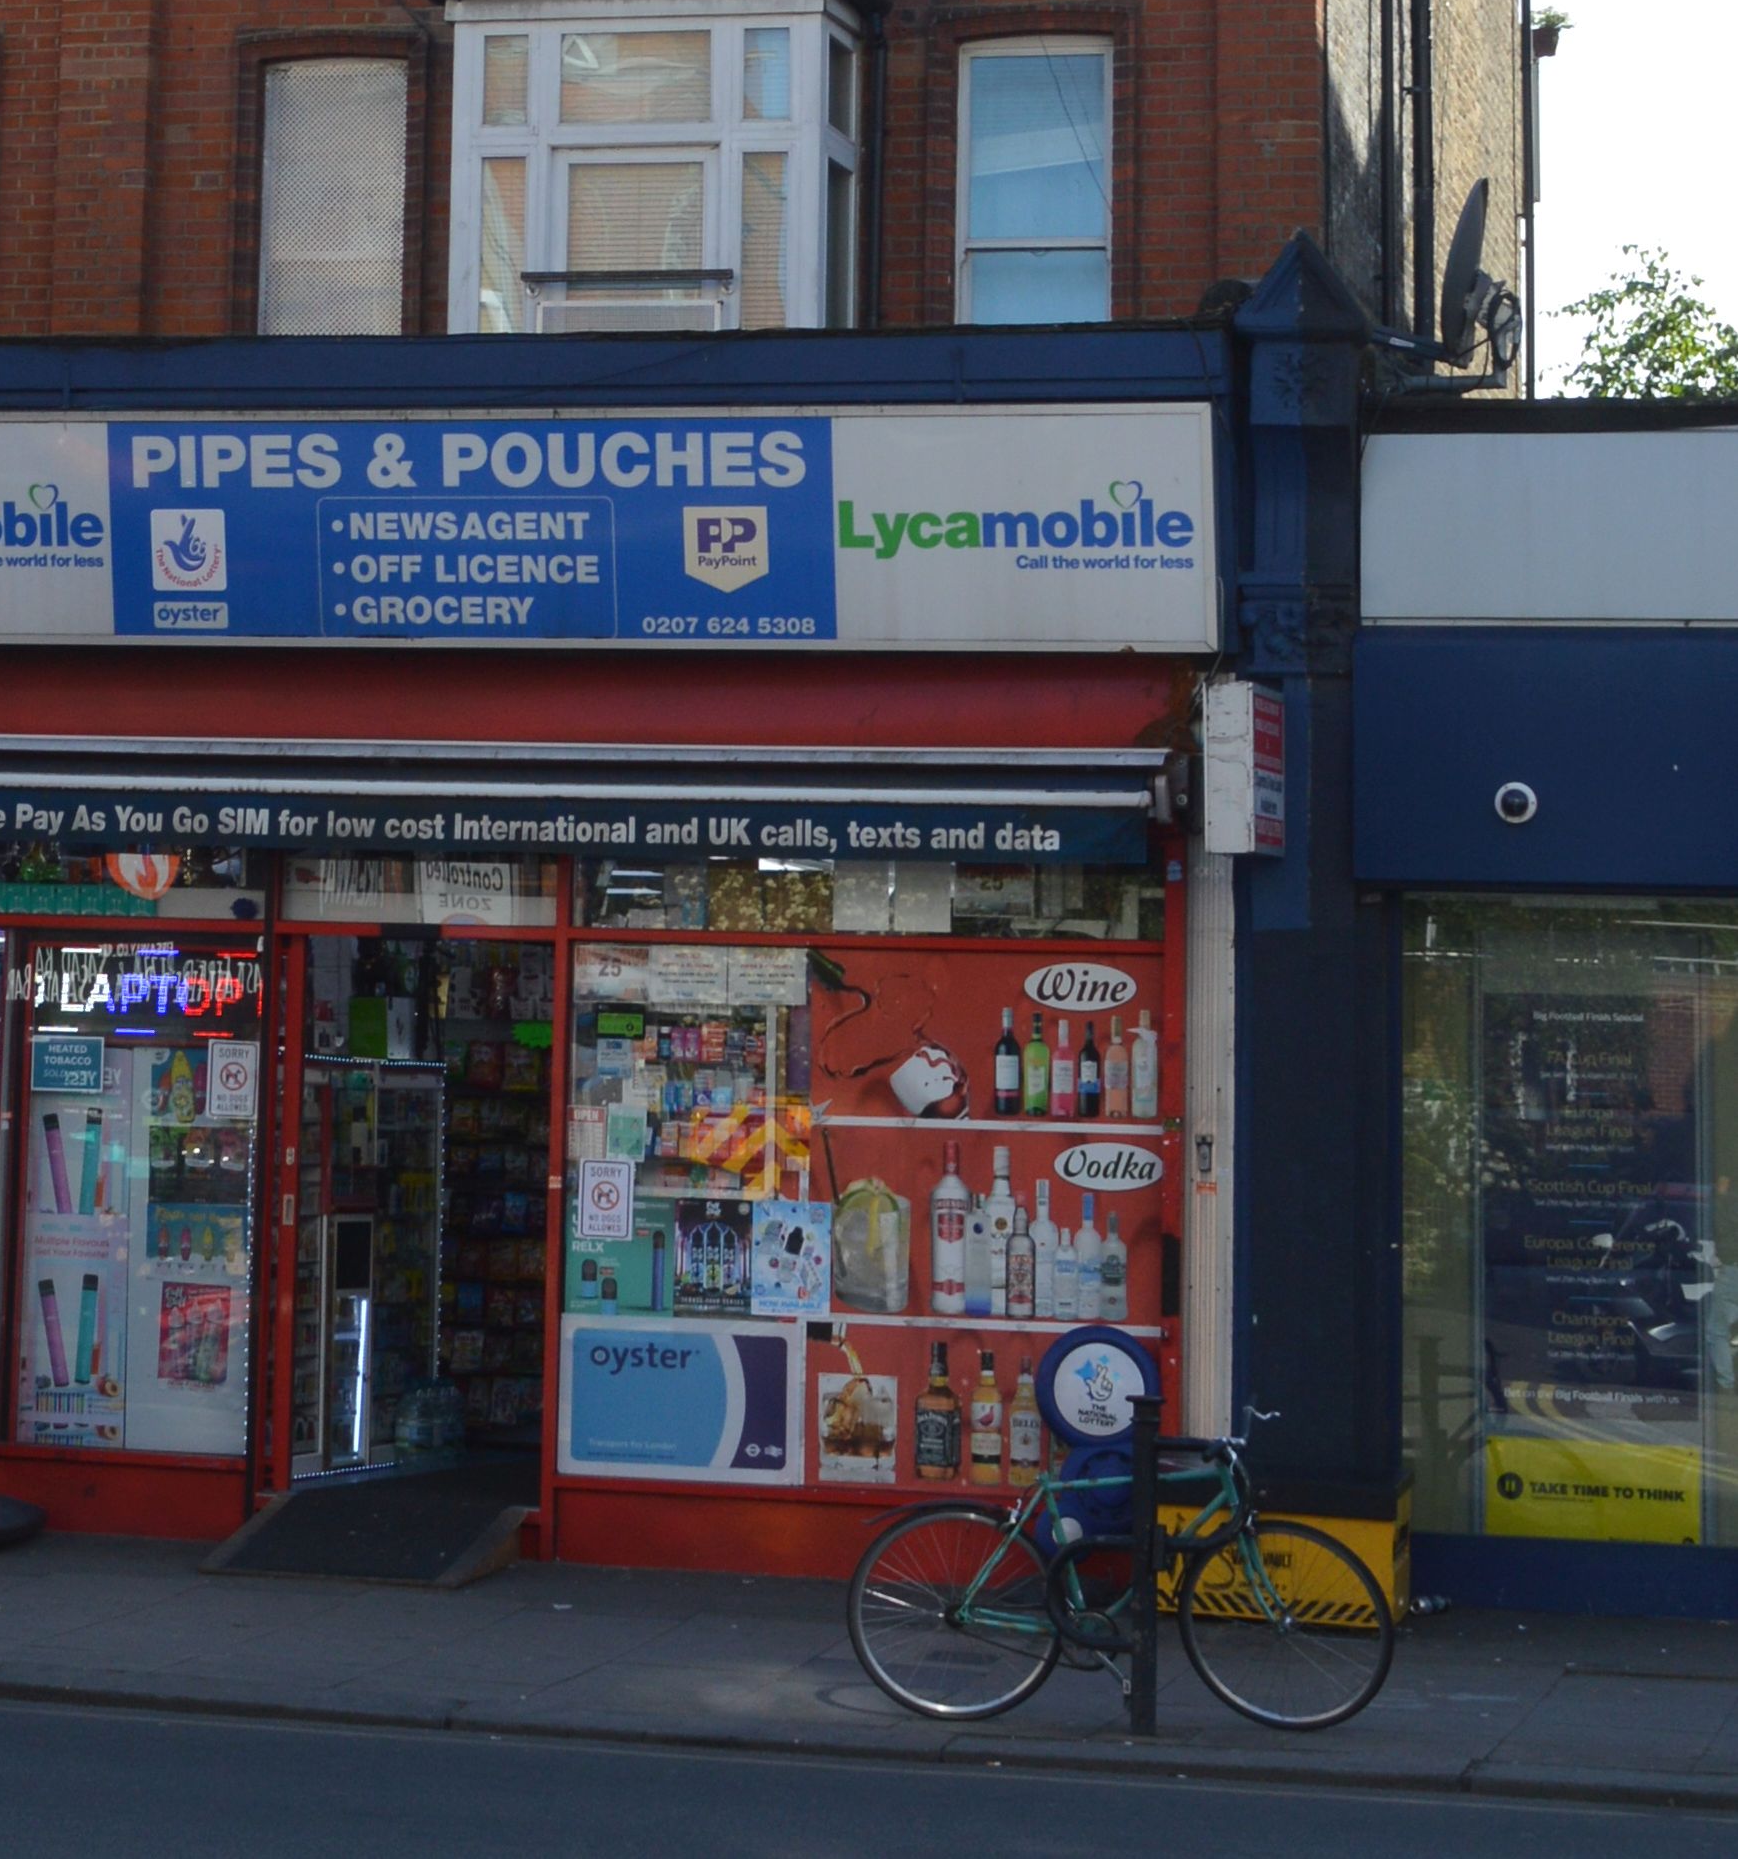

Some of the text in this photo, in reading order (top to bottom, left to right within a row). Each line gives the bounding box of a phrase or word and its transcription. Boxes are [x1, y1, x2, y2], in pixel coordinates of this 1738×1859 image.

[131, 431, 806, 488] PIPES & POUCHES
[349, 511, 589, 541] NEWSAGENT
[838, 496, 1194, 559] Lycamobile
[4, 553, 48, 567] world
[50, 553, 72, 567] for
[73, 553, 104, 567] less
[351, 554, 600, 583] OFF LICENCE
[697, 555, 757, 569] PayPoint
[1016, 554, 1194, 570] Call the world for less
[162, 565, 202, 588] National
[157, 604, 220, 626] oyster
[352, 595, 535, 625] GROCERY
[642, 616, 816, 635] 0207 624 5308
[14, 803, 65, 836] Pay
[72, 804, 106, 831] As
[113, 805, 163, 833] You
[171, 807, 208, 835] Go
[217, 808, 269, 837] SIM
[277, 809, 319, 838] for
[326, 811, 375, 839] low
[384, 813, 445, 840] cost
[453, 813, 637, 844] International
[644, 817, 699, 845] and
[707, 817, 752, 846] UK
[760, 818, 838, 853] calls,
[847, 819, 922, 848] texts
[930, 822, 985, 850] and
[995, 822, 1062, 852] data
[60, 972, 245, 1017] LAPTOP
[1036, 967, 1129, 1003] Wine
[48, 1044, 88, 1054] HEATED
[218, 1047, 250, 1059] SORRY
[43, 1055, 92, 1066] TOBACCO
[590, 1165, 623, 1178] SORRY
[1062, 1148, 1157, 1180] Vodka
[1526, 1179, 1652, 1196] Scottish Cup Final
[571, 1240, 604, 1253] RELX
[590, 1342, 692, 1376] oyster
[1554, 1388, 1571, 1402] Big
[1572, 1389, 1613, 1402] Football
[1614, 1391, 1643, 1403] Finals
[1077, 1408, 1117, 1422] NATIONAL
[1079, 1415, 1116, 1428] LOTTERY
[1528, 1481, 1685, 1503] TAKE TIME TO THINK
